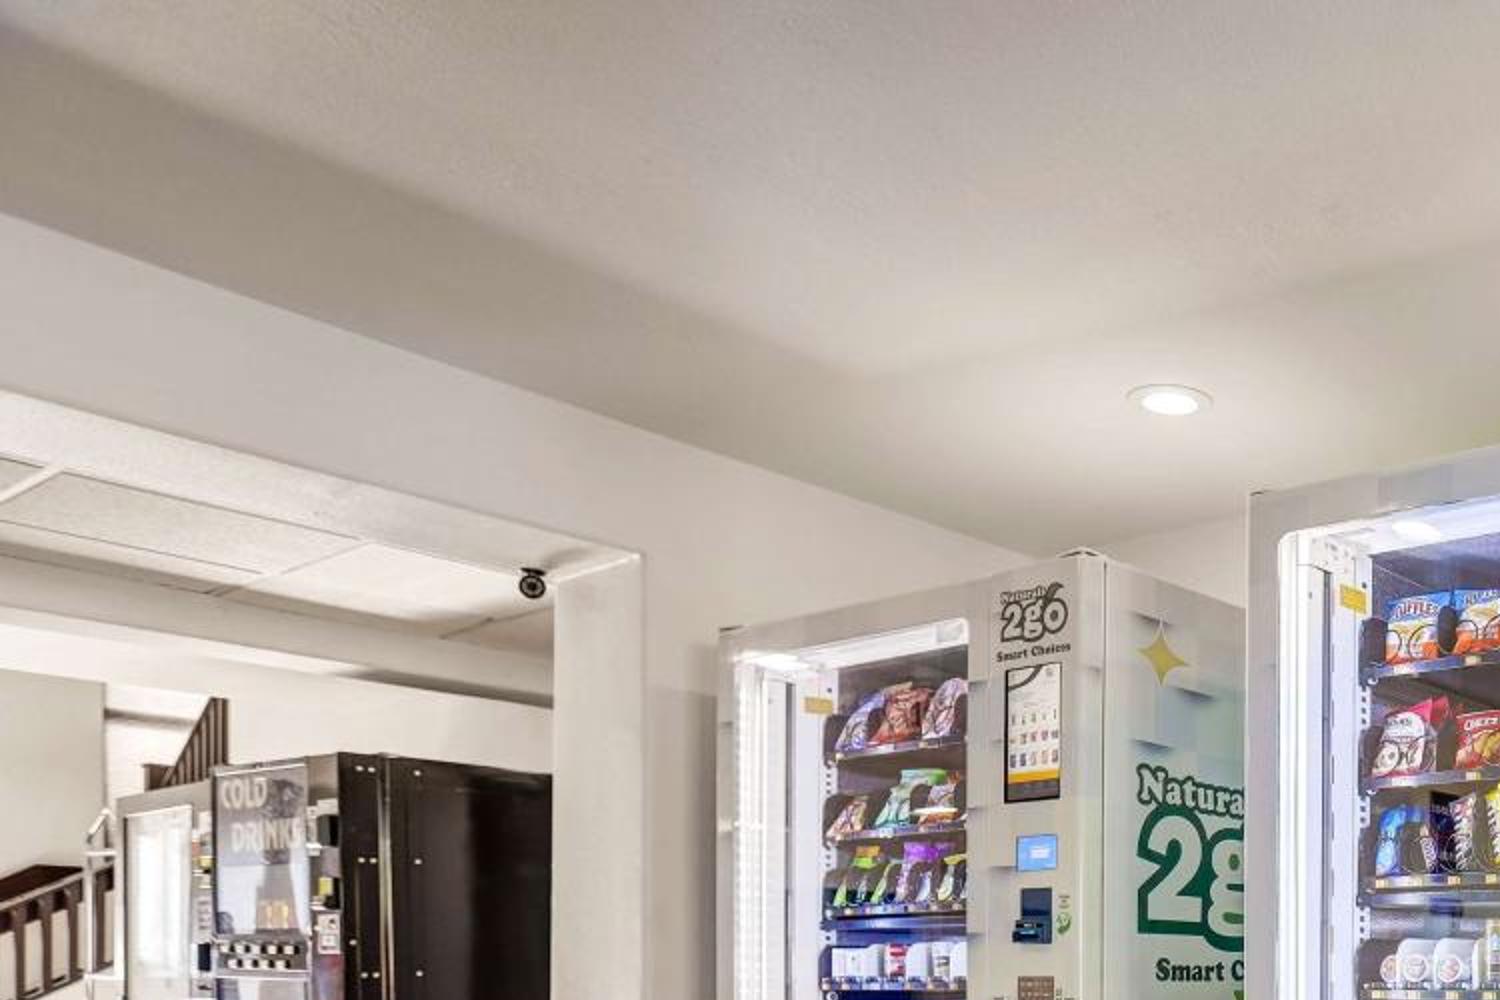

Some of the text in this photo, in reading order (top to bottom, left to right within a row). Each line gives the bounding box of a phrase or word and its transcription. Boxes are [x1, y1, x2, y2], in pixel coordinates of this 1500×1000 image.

[996, 643, 1072, 662] Smart Choices
[222, 777, 268, 810] COLD
[231, 818, 302, 854] DRINKS
[1155, 957, 1225, 983] Smart
